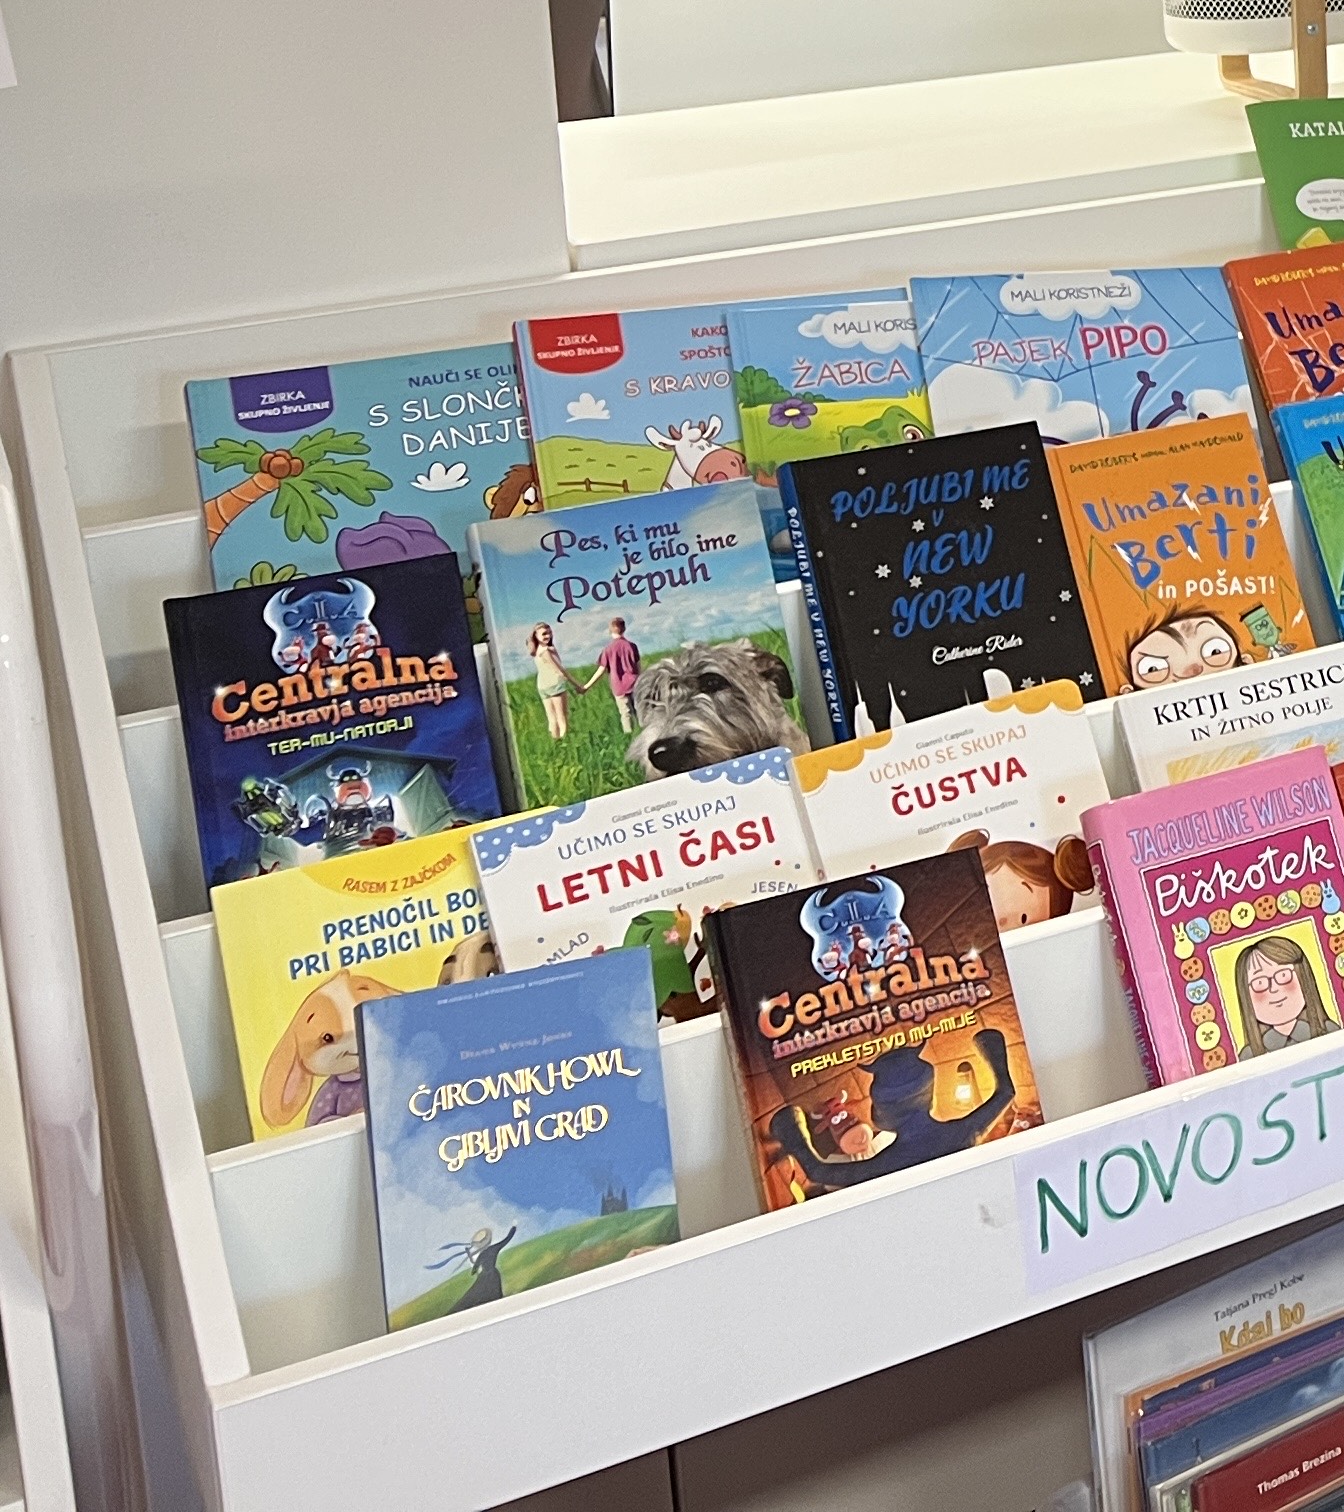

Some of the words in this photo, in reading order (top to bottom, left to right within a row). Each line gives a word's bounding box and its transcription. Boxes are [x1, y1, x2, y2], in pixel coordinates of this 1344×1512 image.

[1011, 287, 1046, 303] MALI
[1048, 282, 1132, 301] KORISTNEŽI
[557, 334, 599, 347] ZBIRKA
[832, 318, 871, 335] MALI
[971, 338, 1073, 367] PAJEK
[1079, 323, 1169, 360] PIPO
[408, 368, 460, 389] NAUČI
[464, 367, 482, 382] SE
[536, 349, 576, 360] SKUPNO
[791, 357, 912, 389] ŽABICA
[260, 390, 306, 406] ZBIRKA
[624, 378, 641, 398] S
[650, 370, 732, 395] KRAVO
[368, 404, 389, 428] S
[402, 416, 532, 457] DANIJE
[831, 468, 976, 522] POLJUBI
[982, 458, 1031, 494] ME
[1082, 474, 1261, 533] Umazani
[540, 529, 609, 569] Pes,
[614, 523, 639, 546] ki
[643, 521, 682, 541] mu
[618, 547, 644, 576] je
[648, 538, 690, 562] bilo
[696, 533, 739, 554] ime
[787, 506, 812, 579] POLJUBI
[902, 524, 994, 581] NEW
[1110, 512, 1258, 590] Berti
[546, 553, 712, 623] Potepuh
[804, 583, 819, 609] ME
[890, 572, 1026, 638] YORKU
[1158, 579, 1178, 600] in
[1186, 569, 1276, 599] POŠAST!
[813, 628, 831, 663] NEW
[931, 644, 985, 666] Catherine
[985, 634, 1024, 654] Rider
[211, 646, 460, 724] Centralna
[821, 668, 843, 724] YORKU
[1153, 691, 1230, 726] KRTJI
[223, 697, 356, 743] interkravja
[358, 682, 459, 716] agencija
[1190, 725, 1211, 742] IN
[1217, 710, 1274, 736] ŽITNO
[1281, 696, 1334, 721] POLJE
[869, 753, 930, 785] UČIMO
[935, 745, 958, 765] SE
[962, 724, 1028, 757] SKUPAJ
[891, 756, 1029, 817] ČUSTVA
[557, 827, 628, 861] UČIMO
[632, 818, 658, 839] SE
[661, 795, 738, 831] SKUPAJ
[1126, 797, 1254, 866] JACQUELINE
[1250, 775, 1333, 828] WILSON
[341, 877, 388, 895] RASEM
[390, 879, 400, 893] Z
[402, 853, 458, 889] ZAJČKOM
[536, 849, 663, 913] LETNI
[678, 815, 776, 868] ČASI
[1154, 835, 1335, 917] Piškotek
[322, 896, 441, 946] PRENOČIL
[289, 950, 331, 980] PRI
[338, 928, 422, 968] BABICI
[428, 919, 456, 945] IN
[757, 946, 991, 1040] Centralna
[771, 1004, 897, 1061] interkravja
[897, 981, 994, 1022] agencija
[790, 1030, 907, 1079] PREKLETSTVO
[909, 1008, 978, 1042] MU-MIJE
[407, 1064, 554, 1122] ČAROVNIK
[546, 1048, 643, 1091] HOWL
[512, 1097, 531, 1119] IN
[534, 1104, 609, 1141] GRAD
[1214, 1297, 1250, 1323] Tatjana
[1251, 1283, 1279, 1305] Pregl
[1279, 1272, 1306, 1291] Kobe
[1278, 1301, 1306, 1333] bo
[1256, 1467, 1301, 1496] Thomas
[1301, 1446, 1343, 1473] Brezina
